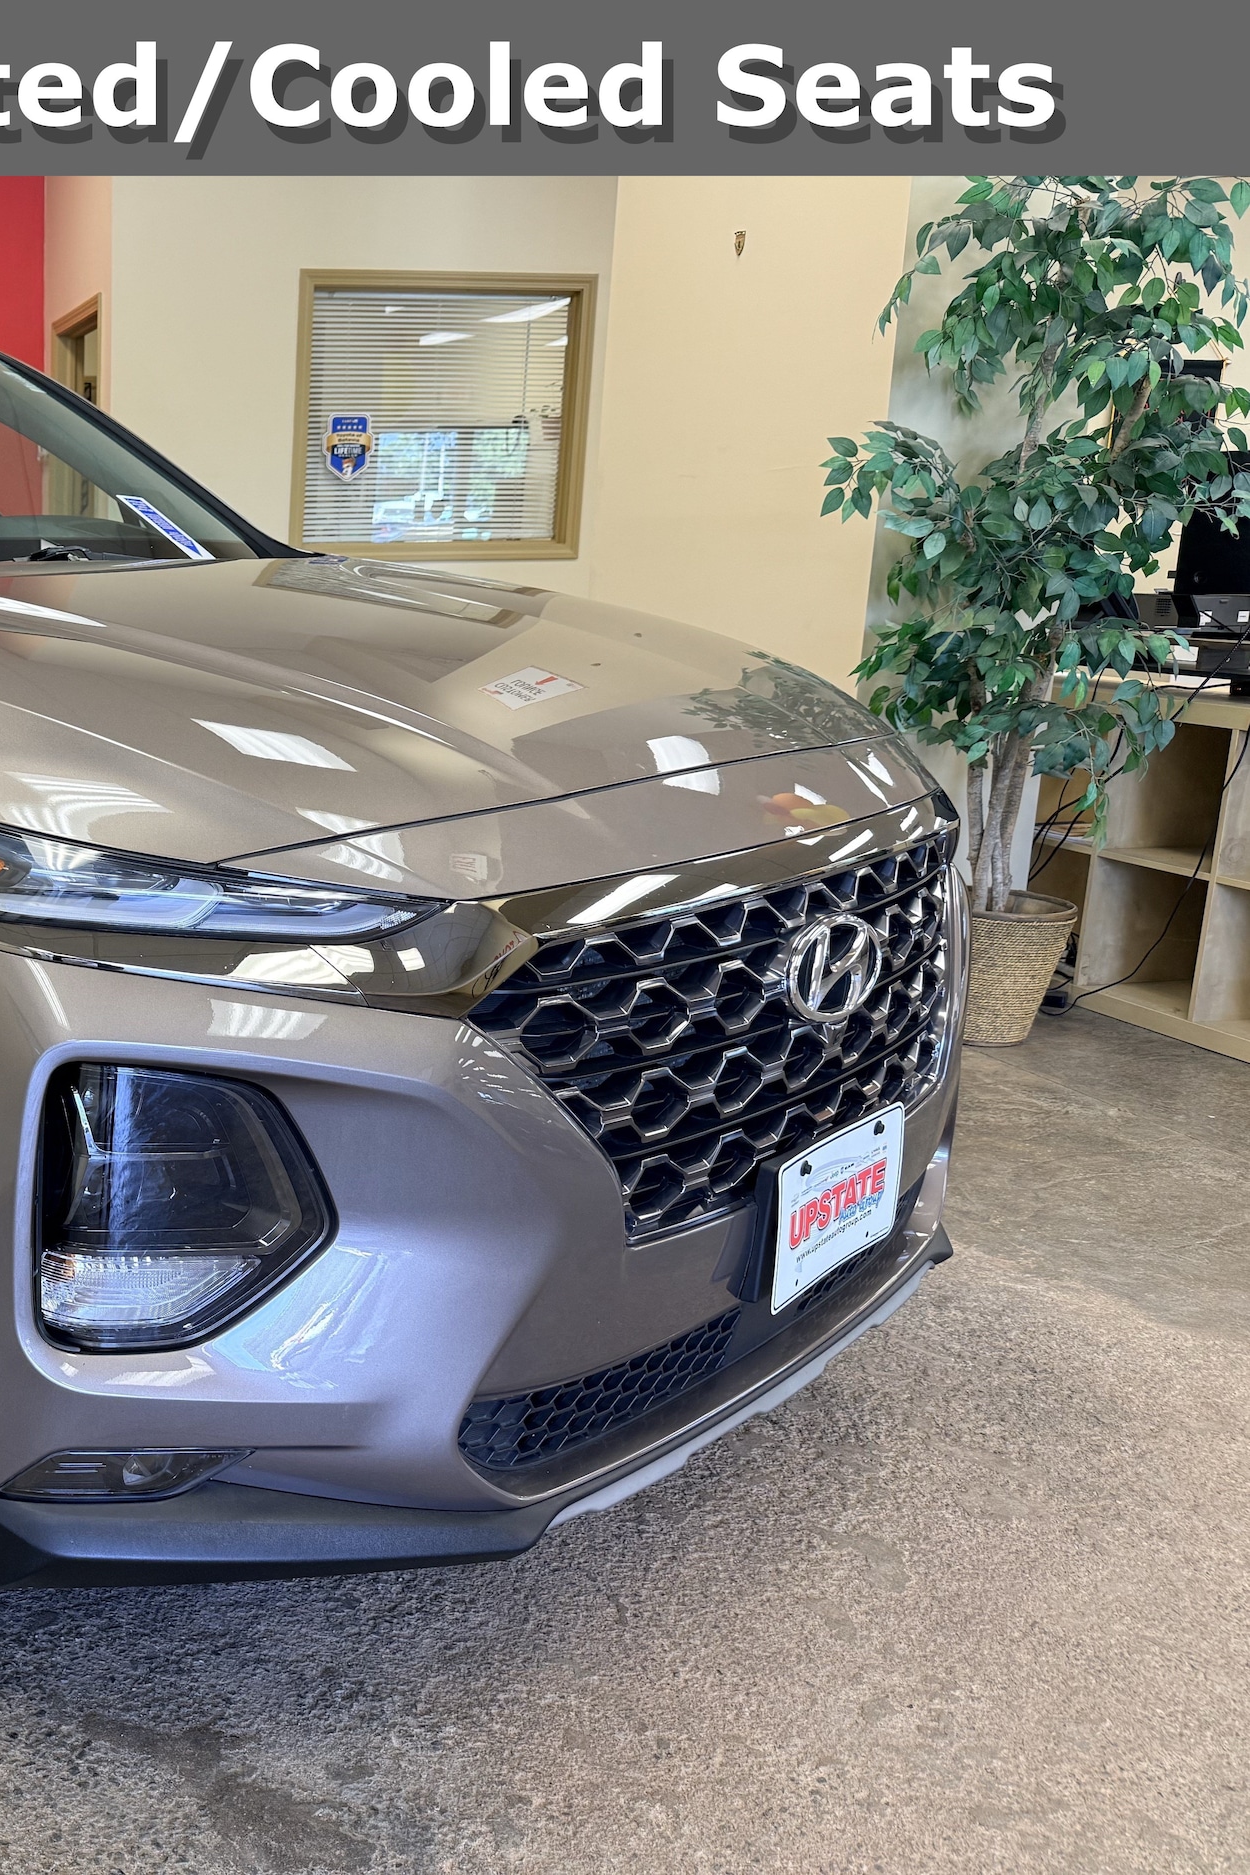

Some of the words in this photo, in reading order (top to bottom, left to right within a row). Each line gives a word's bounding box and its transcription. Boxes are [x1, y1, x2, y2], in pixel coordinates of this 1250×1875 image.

[333, 447, 363, 455] LIFETIME
[788, 1156, 887, 1250] UPSTATE
[796, 1209, 872, 1263] www.upstateautogroup.com
